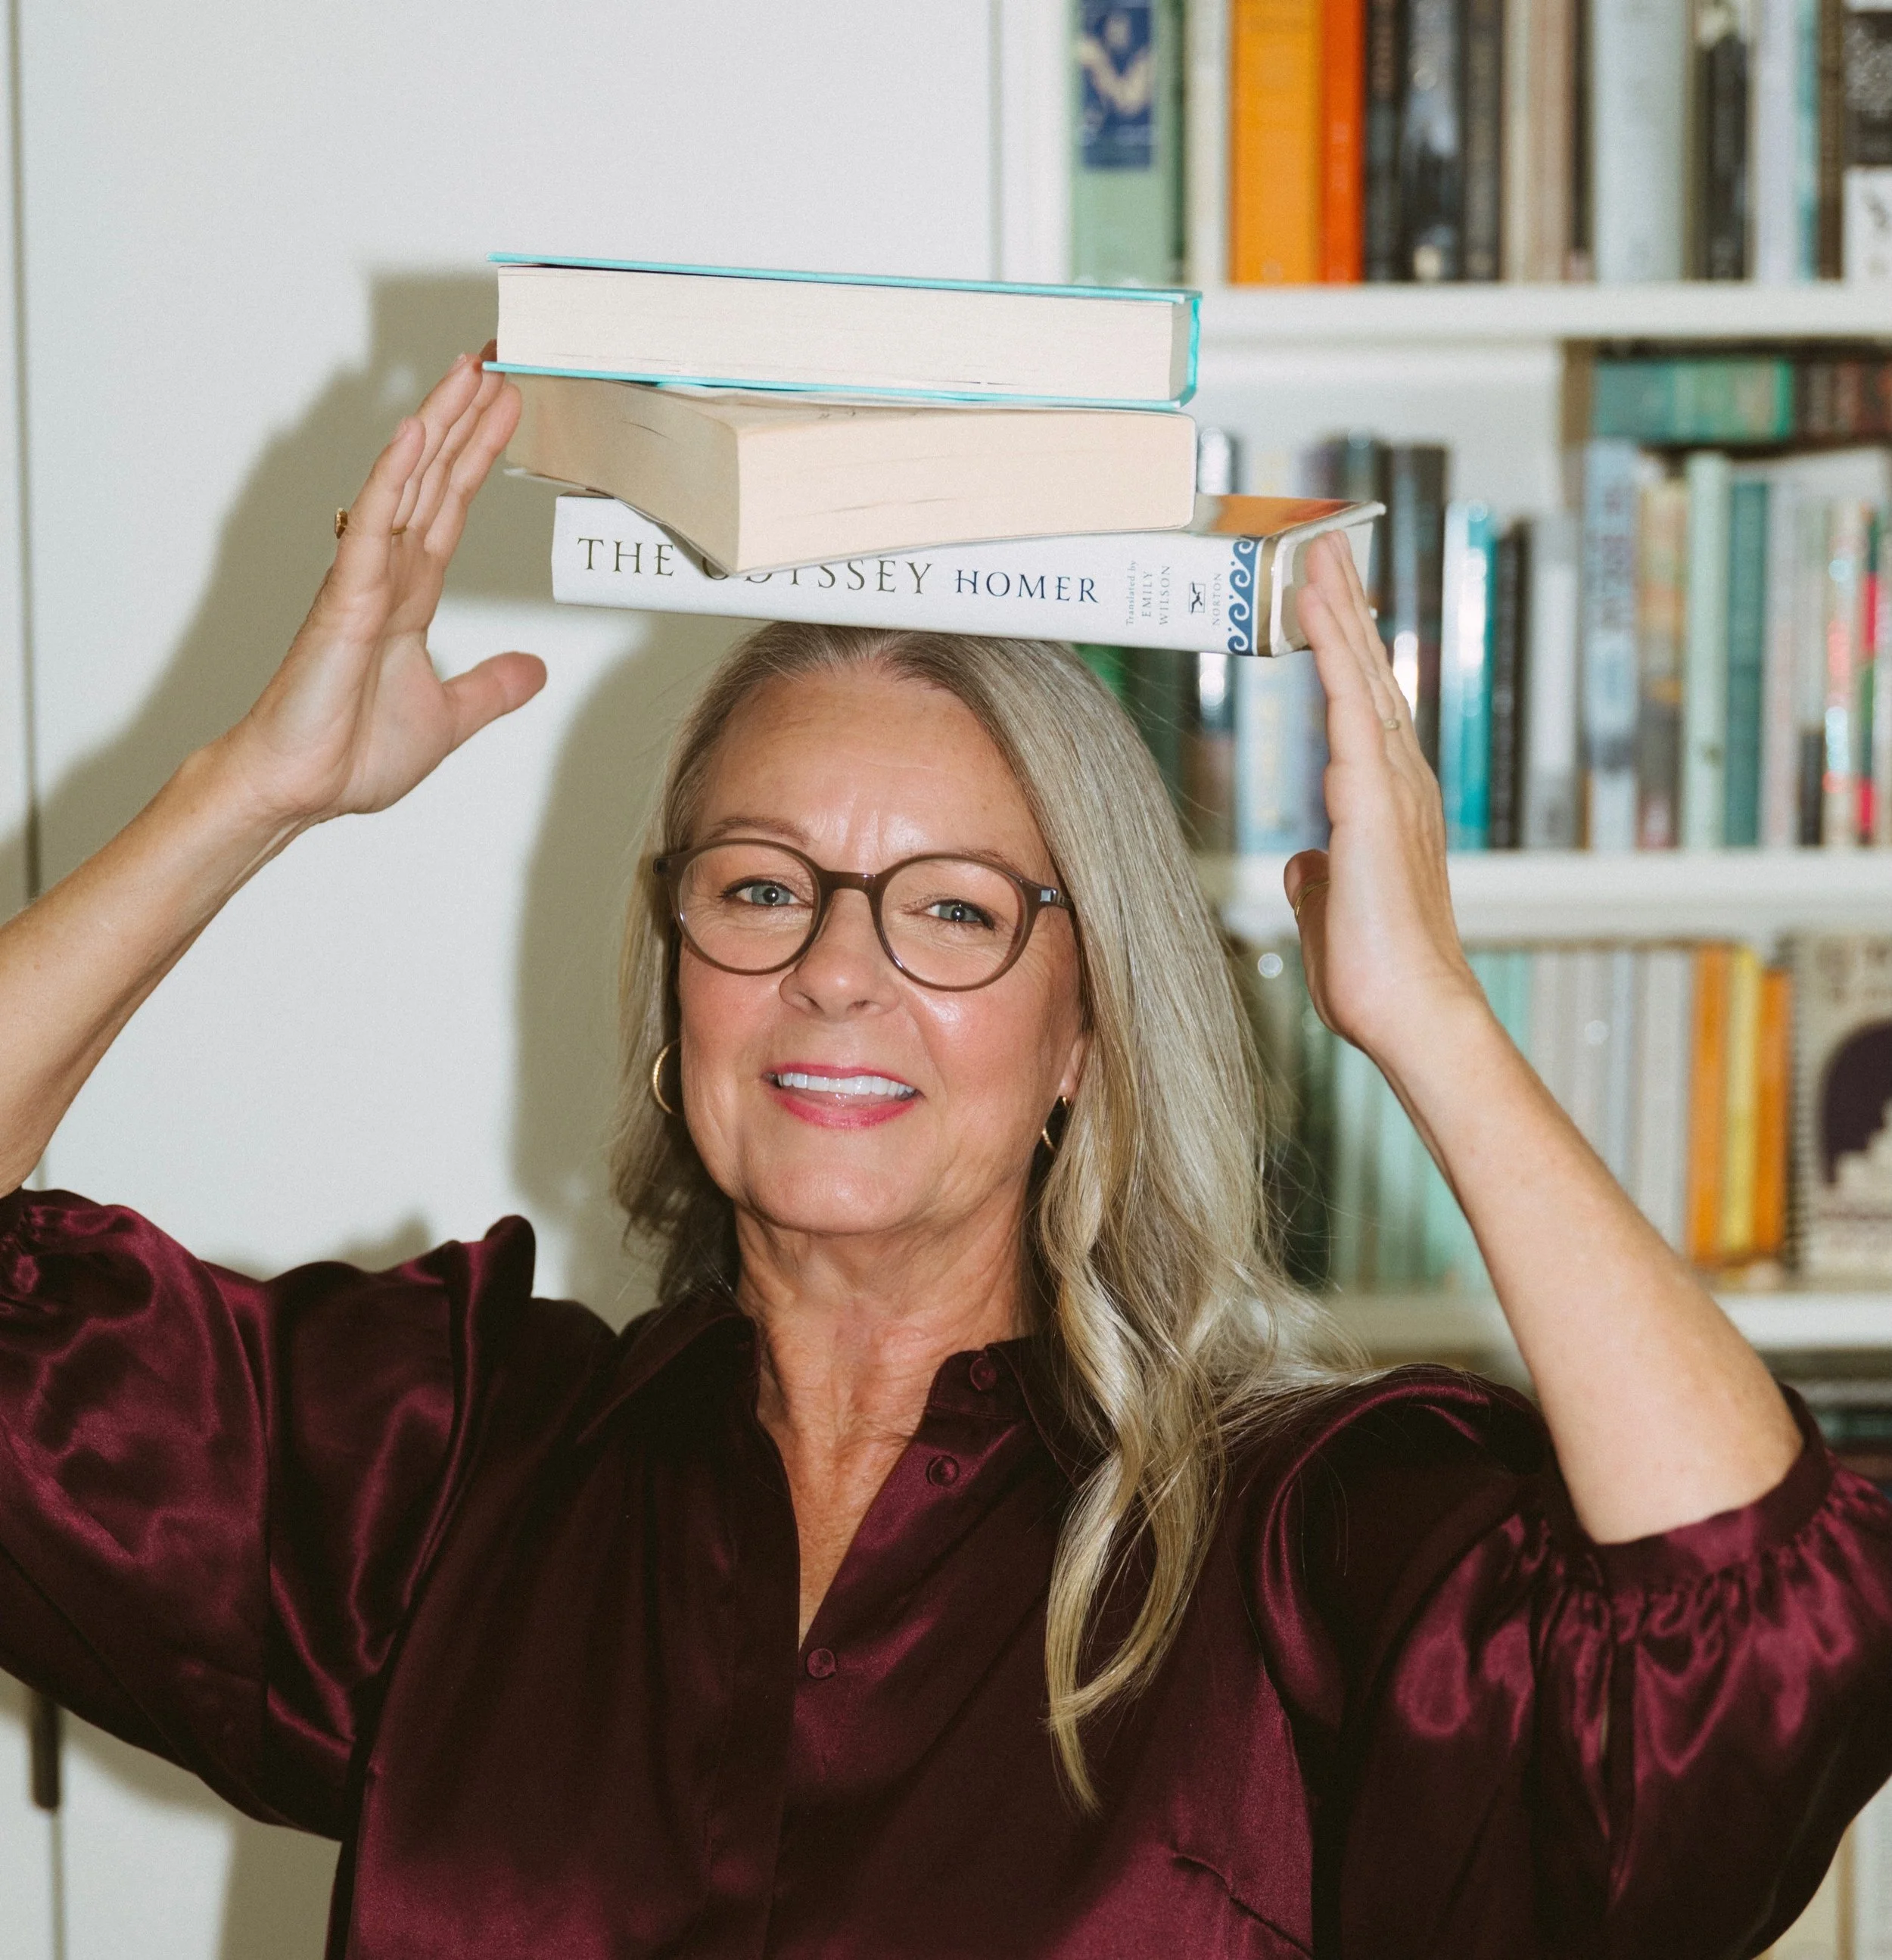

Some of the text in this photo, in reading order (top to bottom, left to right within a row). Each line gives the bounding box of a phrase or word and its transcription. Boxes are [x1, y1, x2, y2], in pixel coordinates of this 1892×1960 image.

[577, 537, 1099, 603] THE SSEY HOMER
[1126, 560, 1138, 626] Translated by
[1141, 571, 1153, 618] EMILY
[1159, 565, 1171, 625] WILSON
[1212, 573, 1221, 627] NORTON
